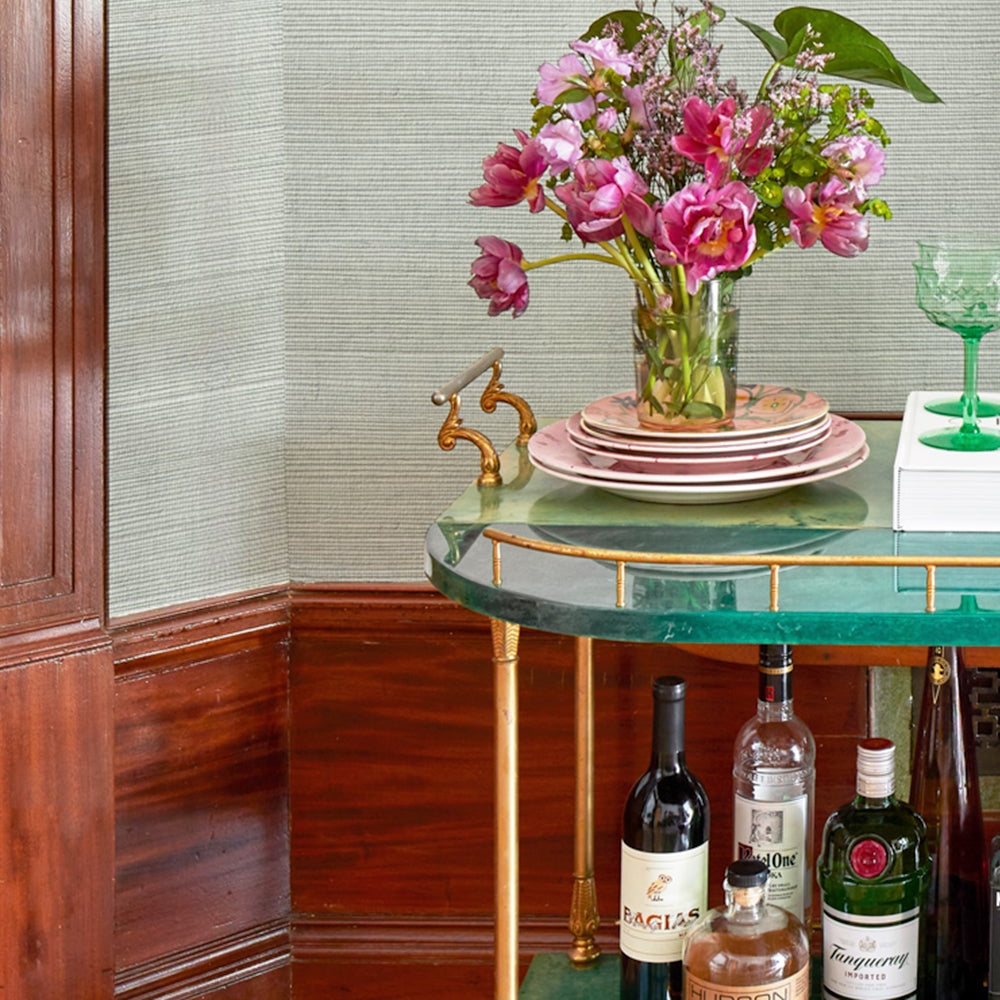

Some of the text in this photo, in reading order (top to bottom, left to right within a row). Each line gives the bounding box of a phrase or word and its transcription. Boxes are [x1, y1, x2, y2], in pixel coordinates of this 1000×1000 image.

[772, 853, 796, 868] One
[830, 944, 909, 971] Tanqueray
[844, 971, 887, 981] IMPORTED
